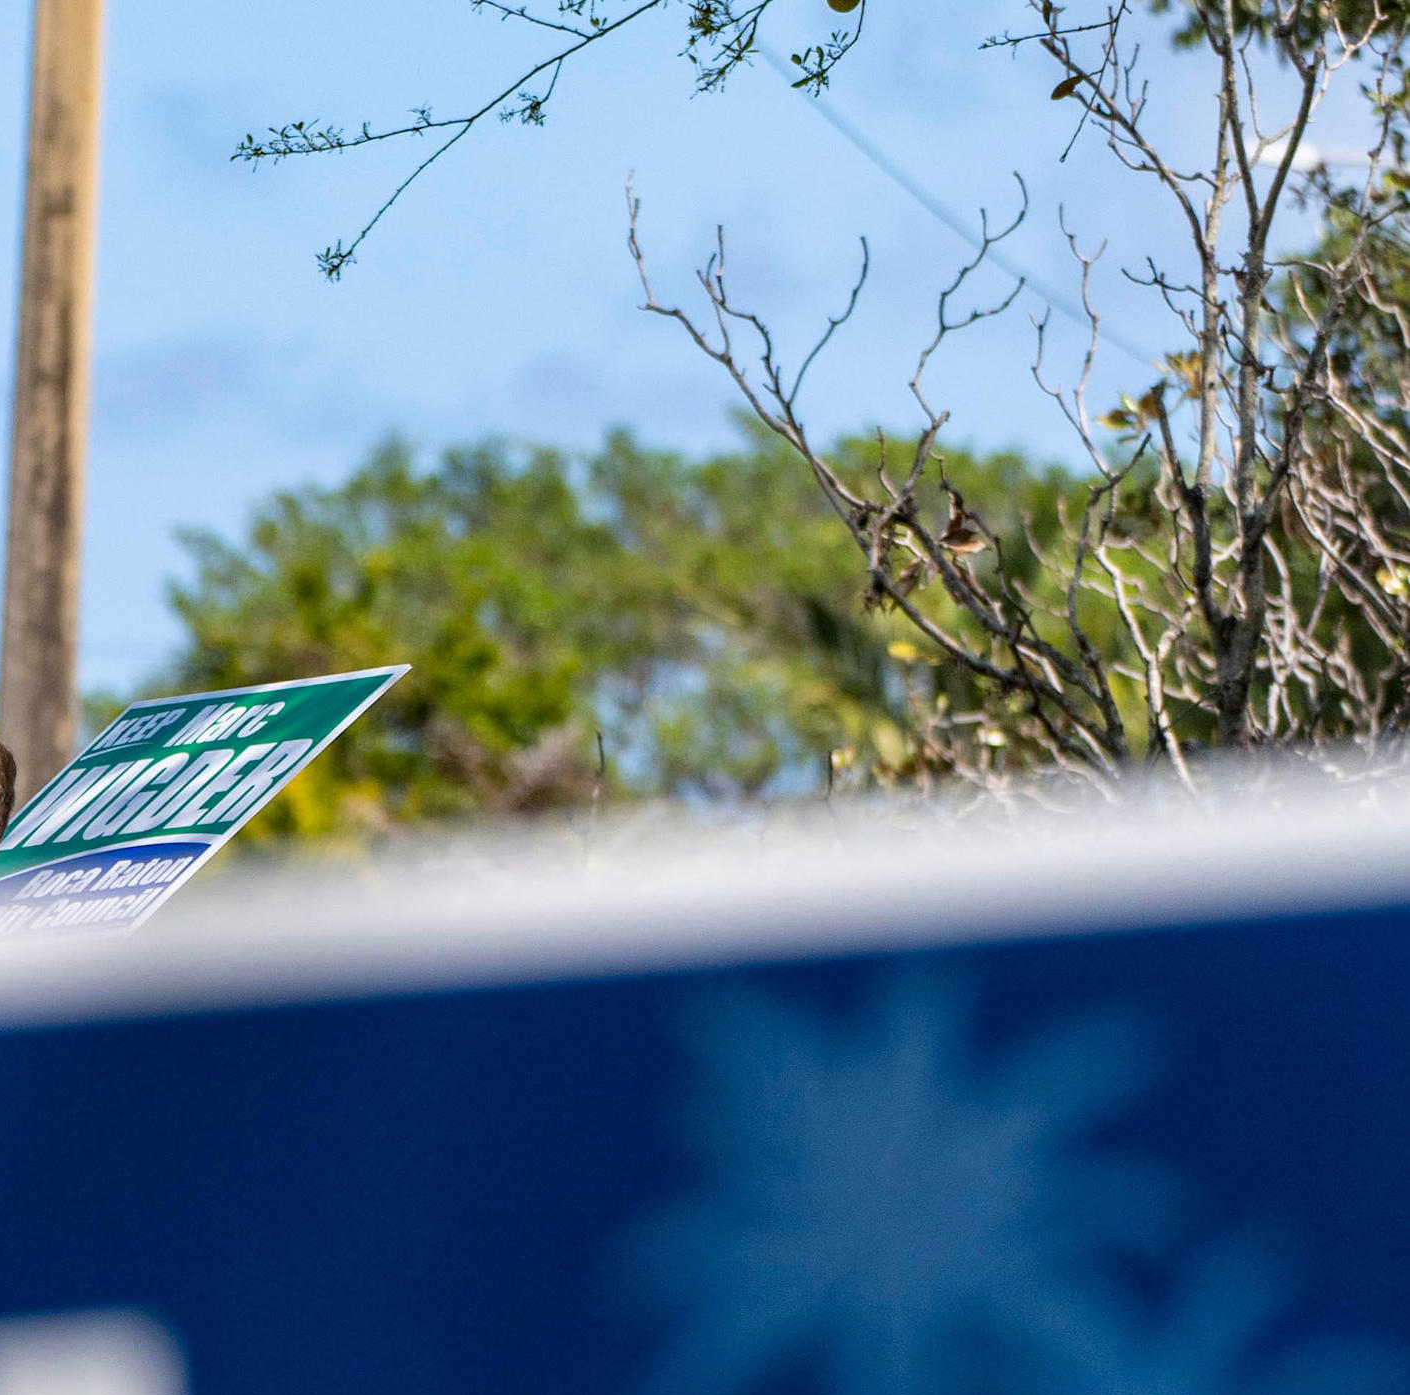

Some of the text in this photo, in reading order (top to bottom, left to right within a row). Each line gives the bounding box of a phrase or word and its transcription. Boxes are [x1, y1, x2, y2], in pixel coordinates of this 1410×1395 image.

[91, 701, 286, 751] KEEP Marc
[12, 856, 194, 901] Boca Raton
[29, 886, 164, 930] Council
